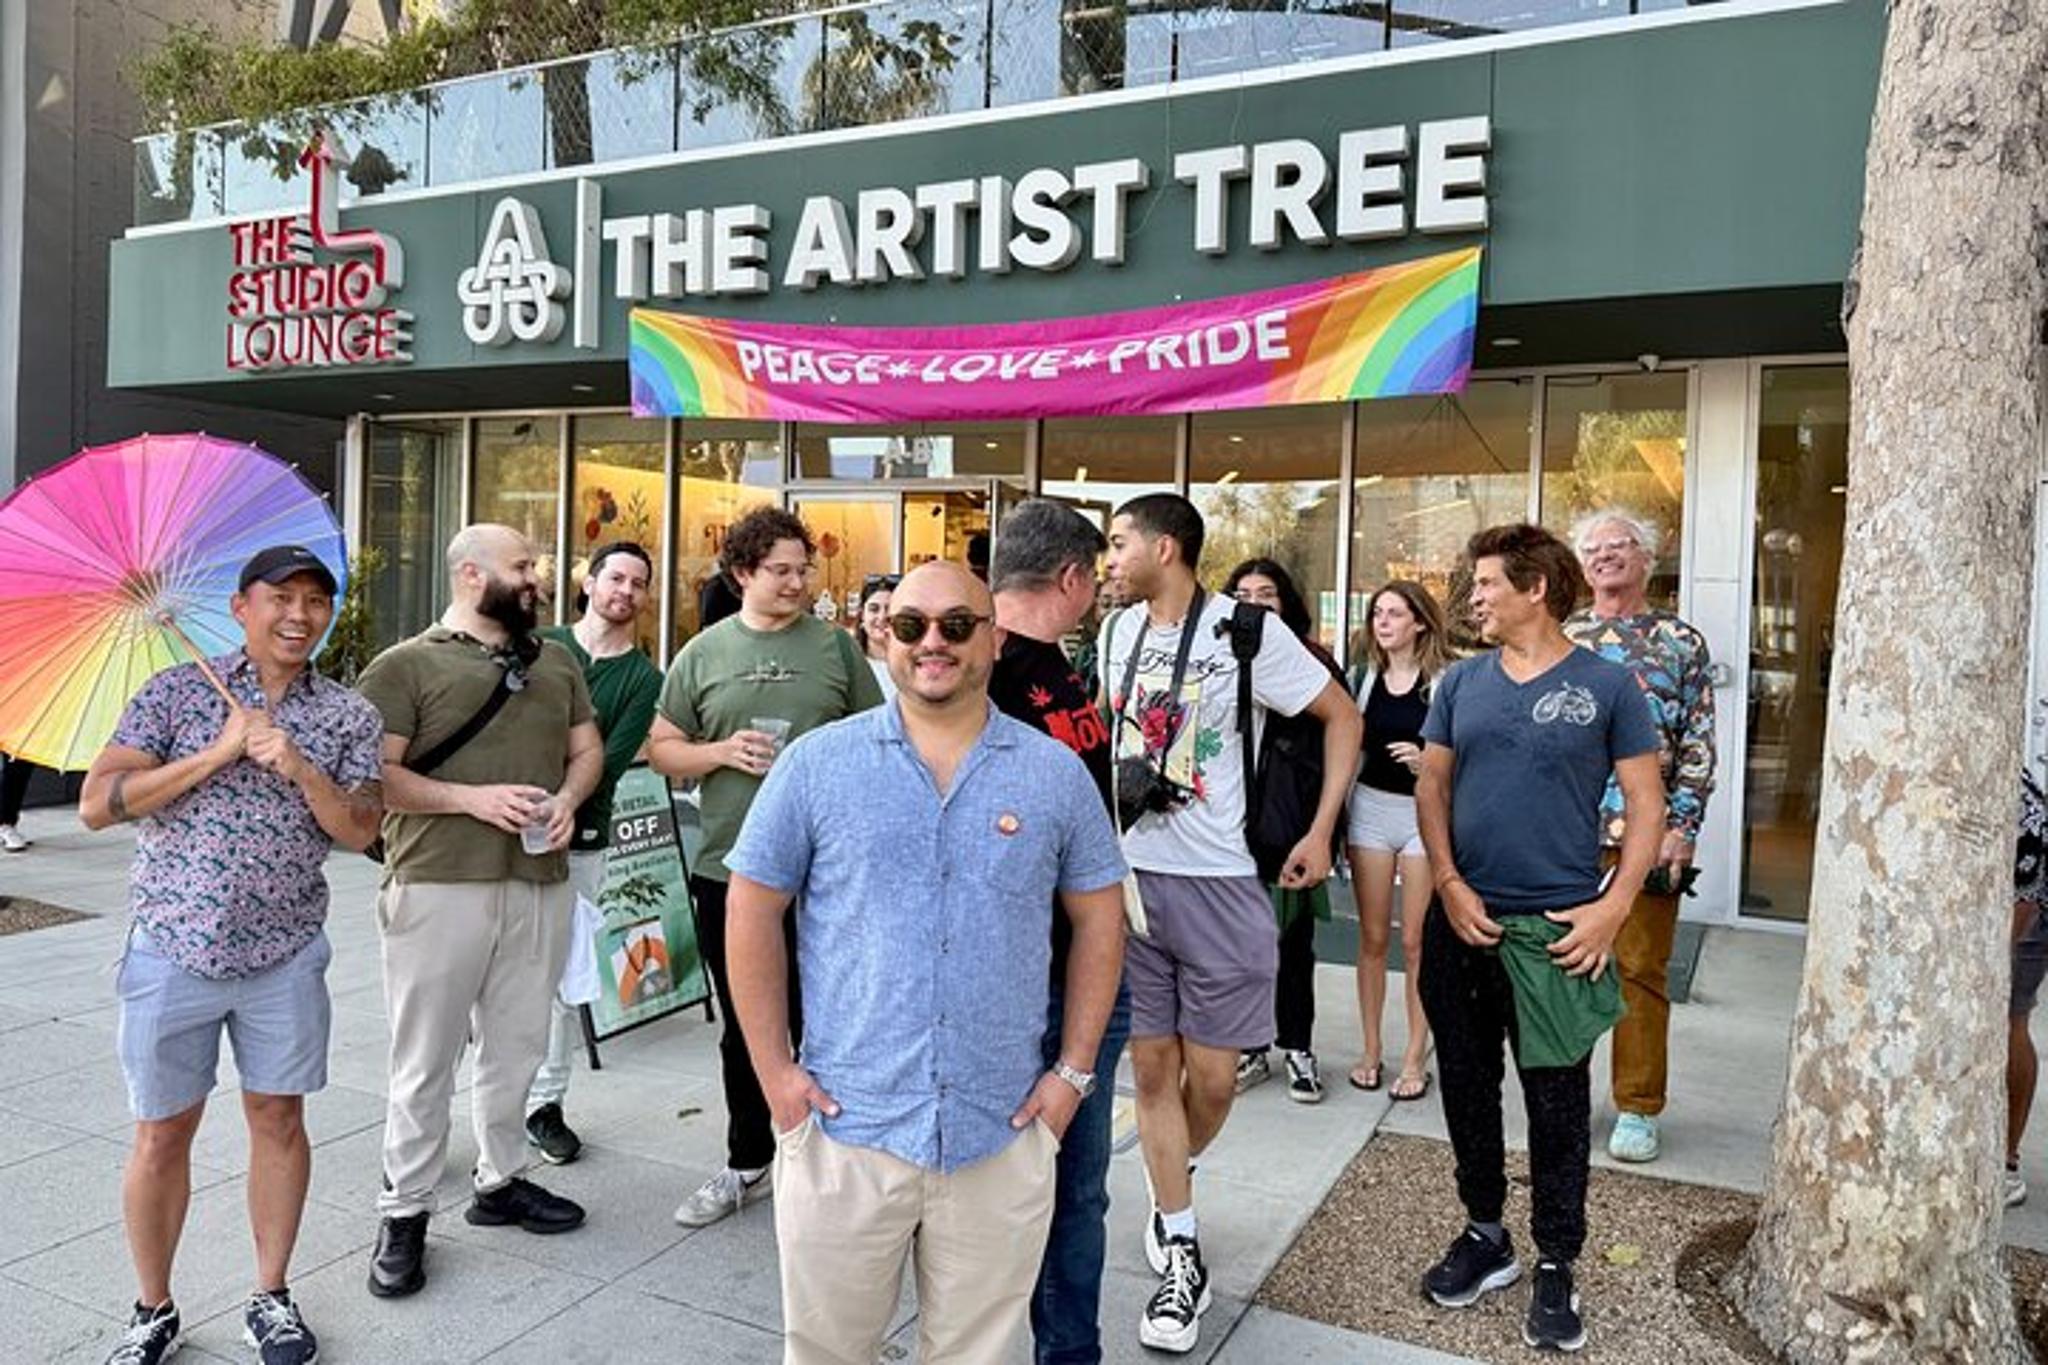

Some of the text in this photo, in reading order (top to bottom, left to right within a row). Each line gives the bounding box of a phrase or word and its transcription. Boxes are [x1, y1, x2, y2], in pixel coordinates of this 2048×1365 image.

[603, 115, 1491, 300] THE ARTIST TREE
[227, 214, 313, 268] THE
[226, 259, 380, 318] STUDIO
[226, 307, 410, 370] LOUNGE
[737, 309, 1292, 385] PEACE LOVE PRIDE
[617, 815, 659, 841] OFF
